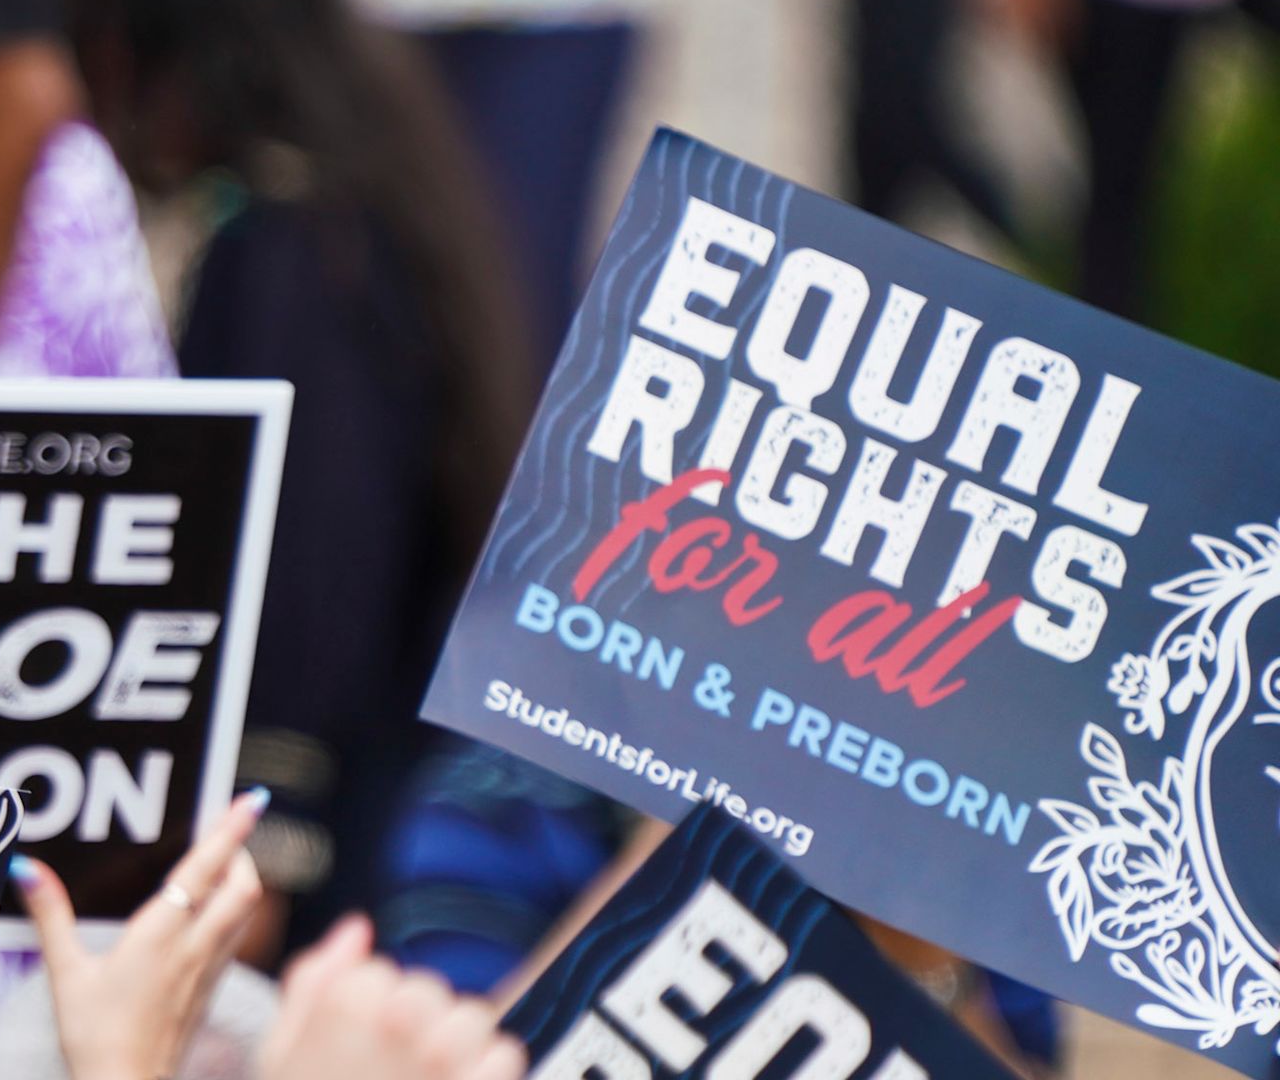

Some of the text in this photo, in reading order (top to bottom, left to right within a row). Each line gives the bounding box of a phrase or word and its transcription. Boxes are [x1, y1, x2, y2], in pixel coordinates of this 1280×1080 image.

[639, 196, 1149, 536] EQUAL
[571, 468, 1023, 709] for all
[586, 333, 1129, 664] RIGHTS
[483, 678, 815, 857] StudentsforLife.org
[514, 582, 1032, 846] BORN & PREBORN
